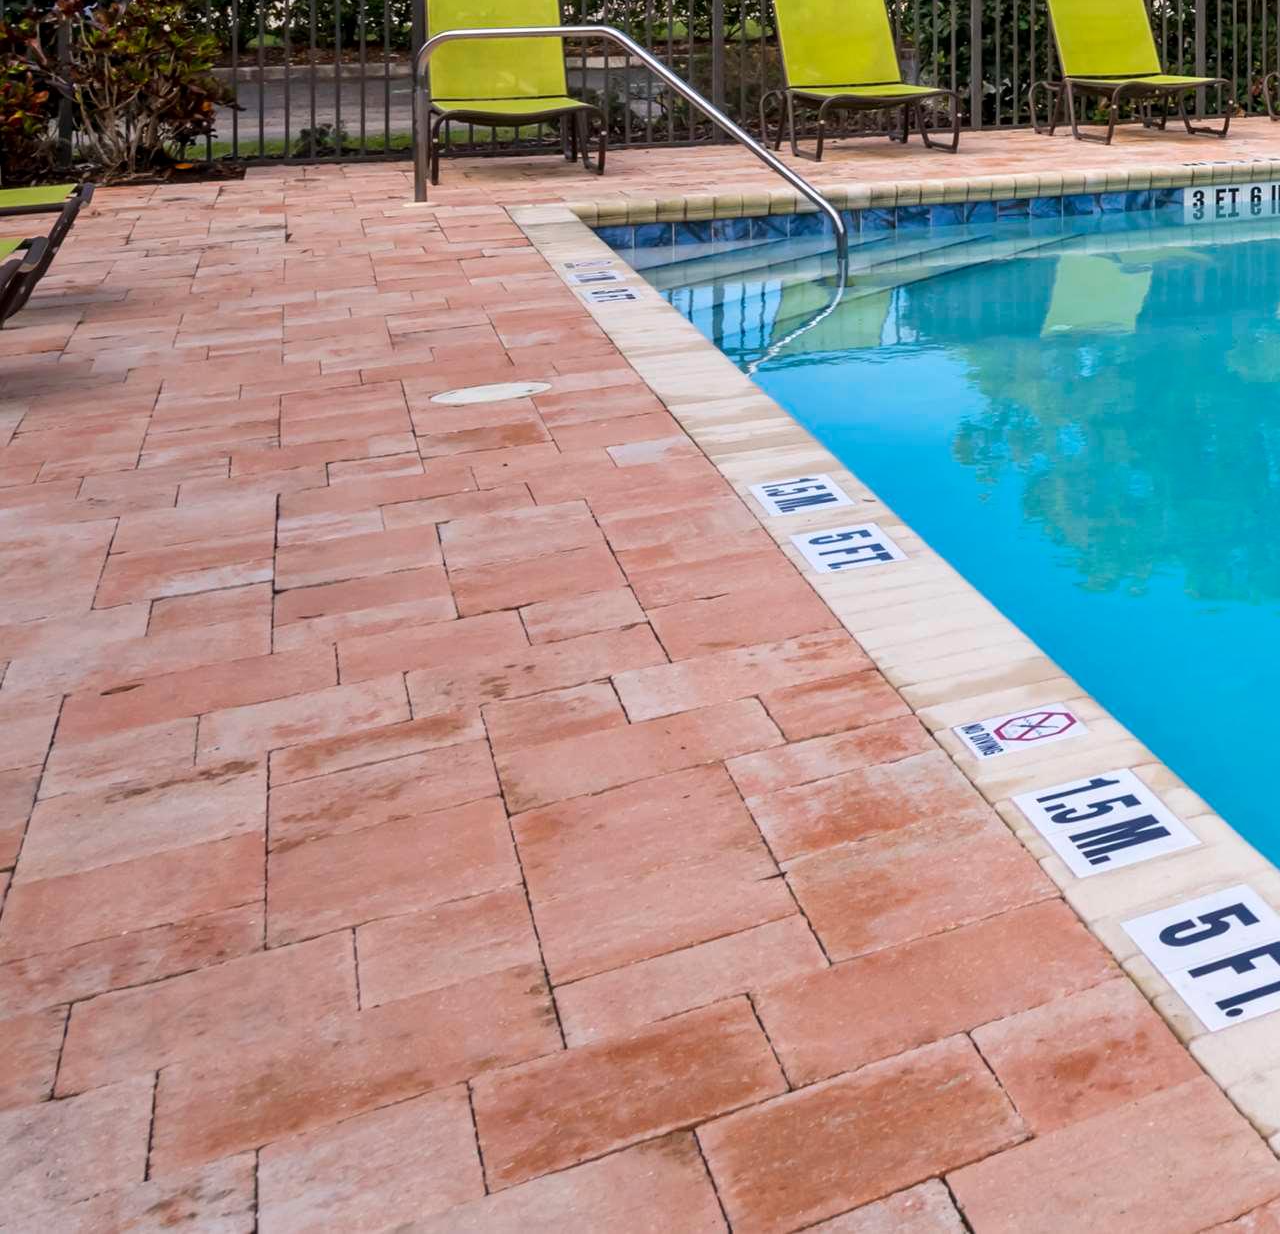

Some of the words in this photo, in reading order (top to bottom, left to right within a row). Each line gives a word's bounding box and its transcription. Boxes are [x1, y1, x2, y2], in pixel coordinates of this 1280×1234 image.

[1193, 191, 1204, 206] 3
[1216, 188, 1239, 204] FT
[1251, 187, 1261, 202] 6
[808, 529, 872, 545] 5
[1036, 777, 1142, 824] 1.5
[1159, 902, 1260, 947] 5
